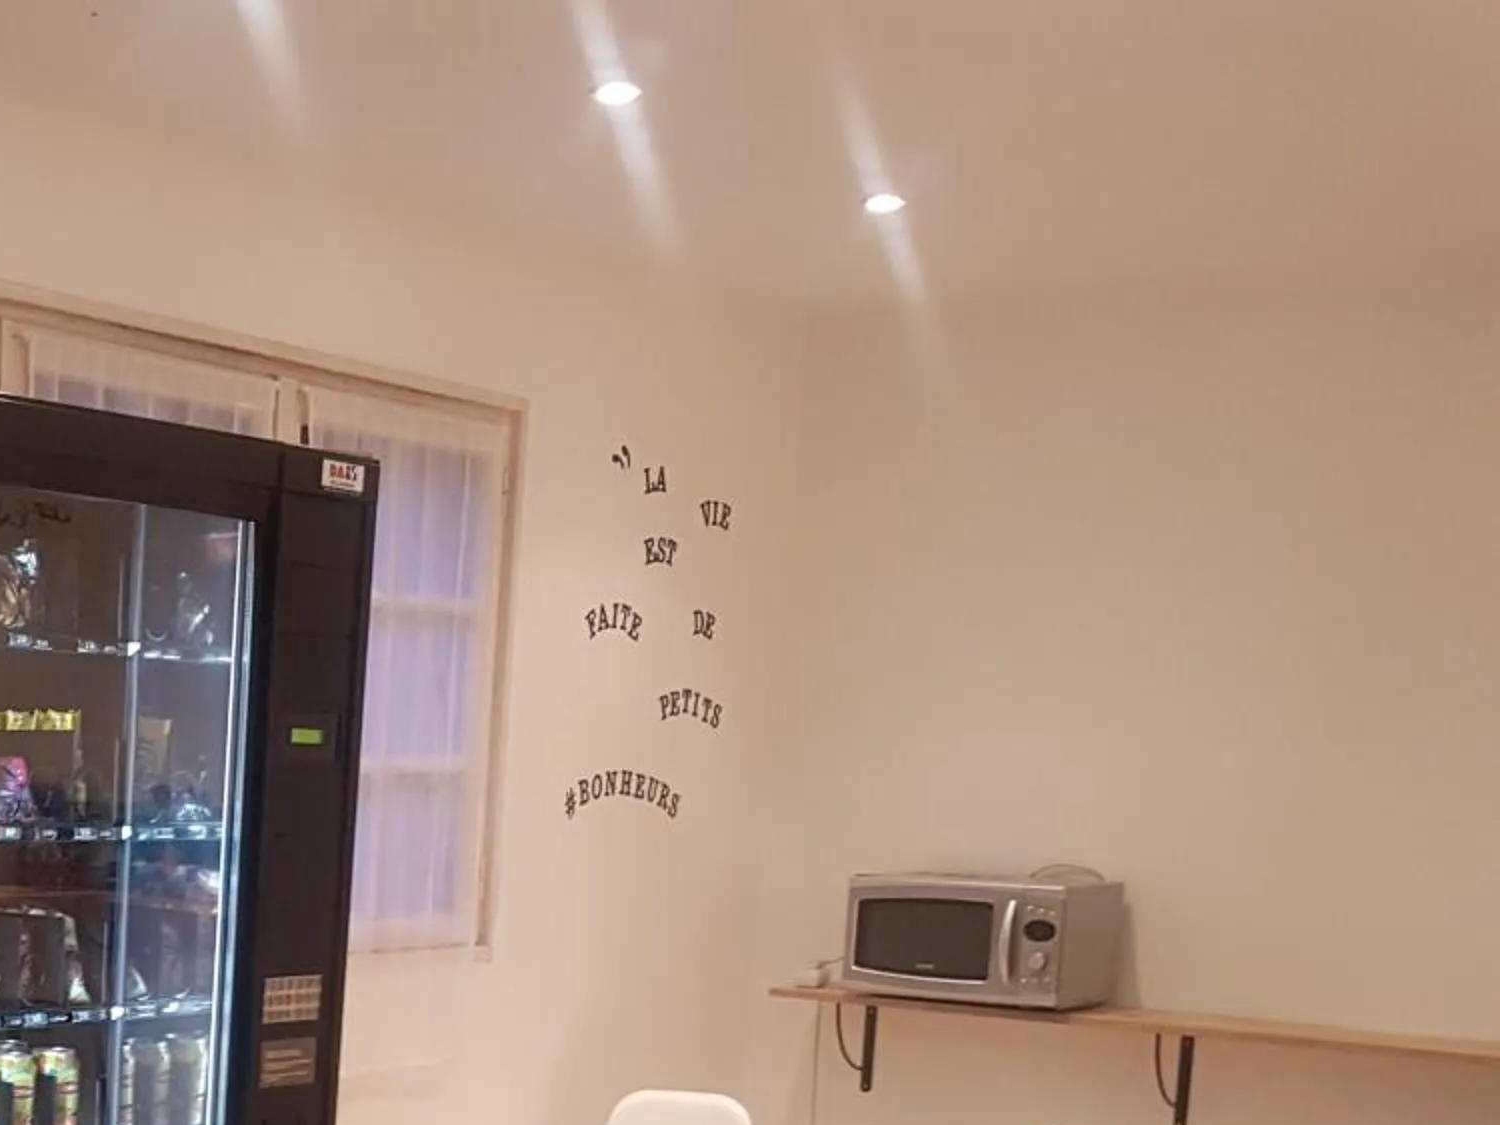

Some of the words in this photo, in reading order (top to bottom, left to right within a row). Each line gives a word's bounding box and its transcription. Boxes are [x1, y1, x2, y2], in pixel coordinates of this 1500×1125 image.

[643, 466, 667, 494] LA
[700, 500, 732, 531] VIE
[644, 537, 678, 567] EST
[584, 603, 643, 642] FAITE
[692, 609, 717, 641] DE
[659, 688, 723, 729] PETITS
[565, 769, 681, 819] #BONHEURS
